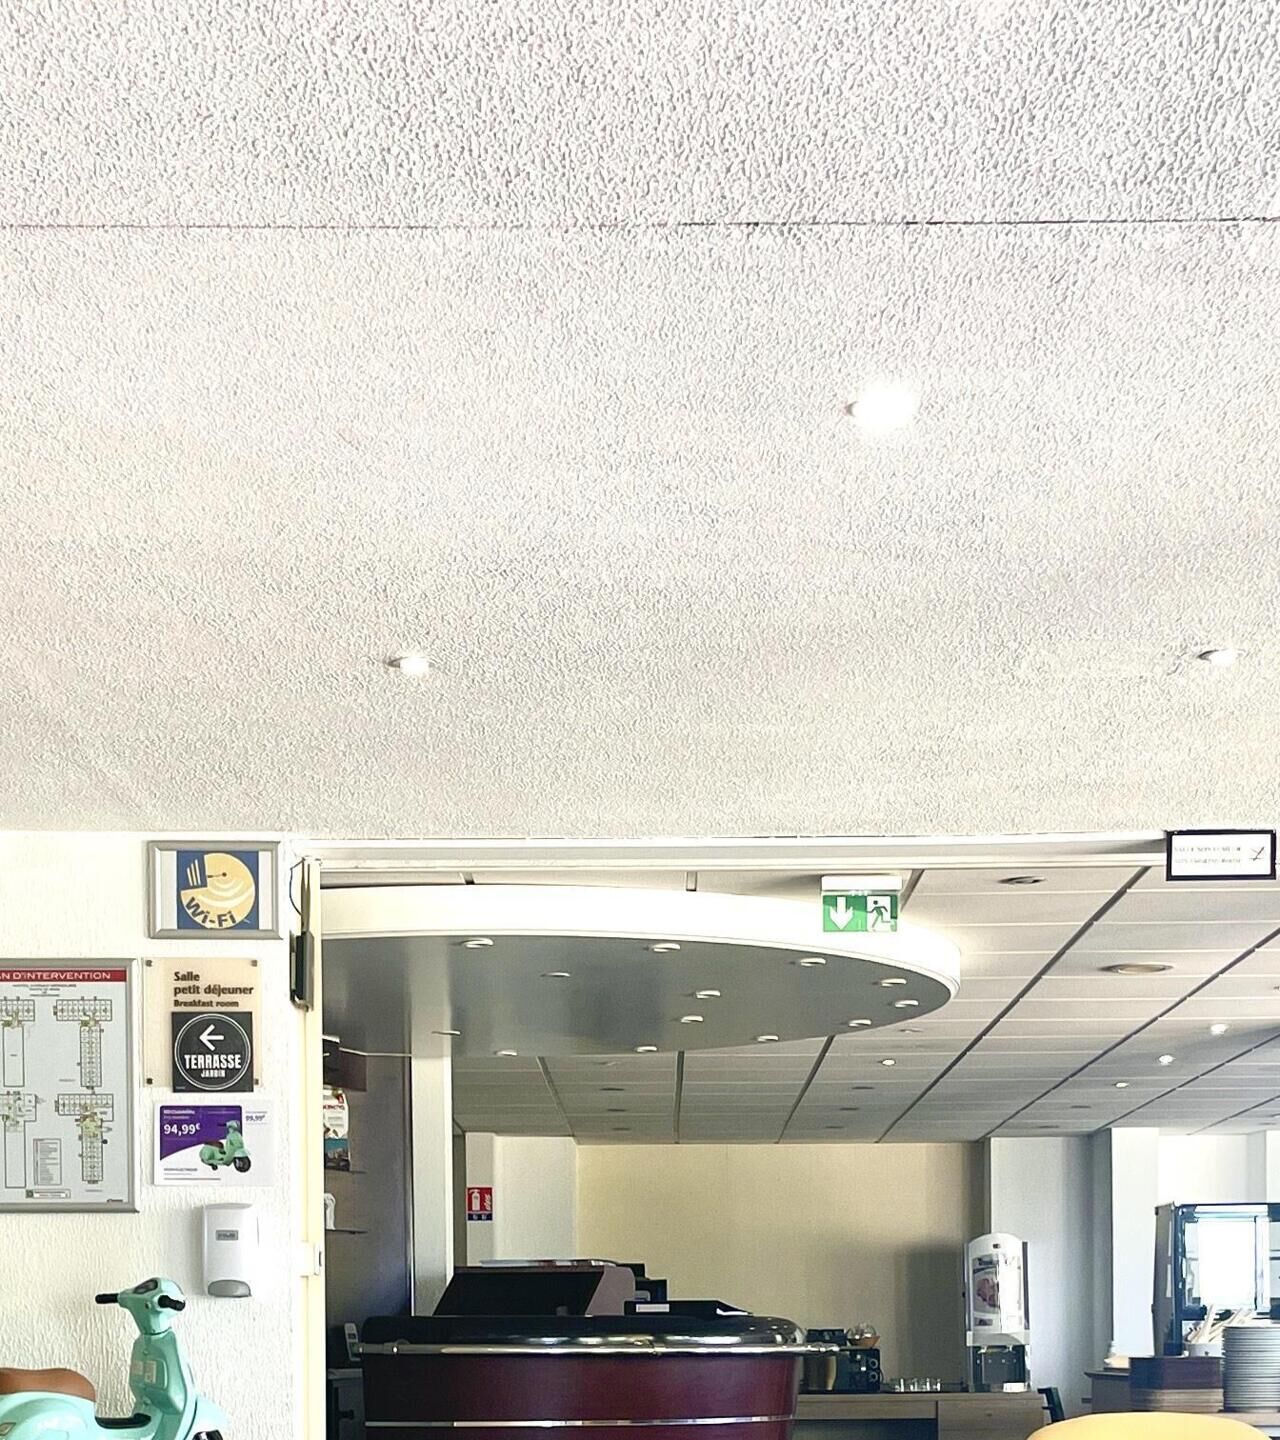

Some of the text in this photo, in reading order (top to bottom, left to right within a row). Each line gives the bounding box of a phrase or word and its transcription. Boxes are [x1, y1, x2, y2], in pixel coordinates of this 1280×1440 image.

[185, 896, 237, 928] Wi-Fi
[13, 971, 111, 981] D'INTERVENTION
[173, 971, 200, 982] Salle
[173, 984, 254, 997] petit déjeuner
[173, 999, 239, 1008] Breakfast room
[184, 1054, 242, 1070] TERRASSE
[200, 1069, 226, 1078] JARDIN
[163, 1122, 201, 1137] 94,99€
